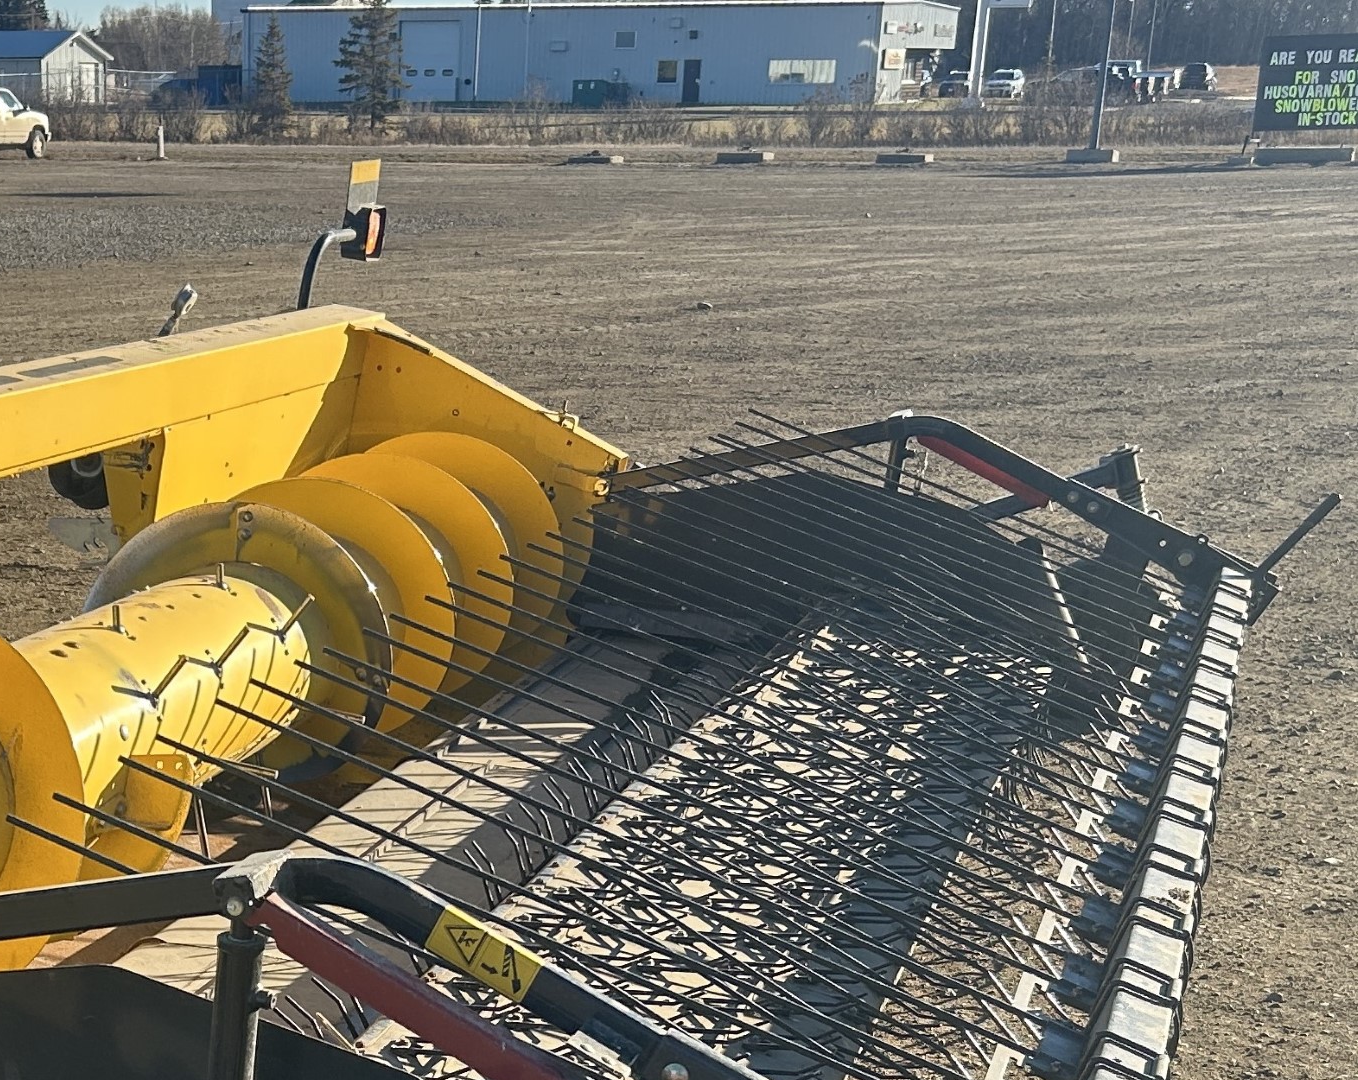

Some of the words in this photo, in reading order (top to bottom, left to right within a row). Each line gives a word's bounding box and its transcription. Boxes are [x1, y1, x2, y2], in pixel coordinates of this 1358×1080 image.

[1269, 51, 1296, 66] ARE
[1306, 50, 1332, 64] YOU
[1295, 70, 1320, 85] FOR
[1330, 69, 1358, 84] SNO
[1275, 97, 1358, 113] SNOWBLOWE
[1297, 111, 1358, 127] IN-STOCK
